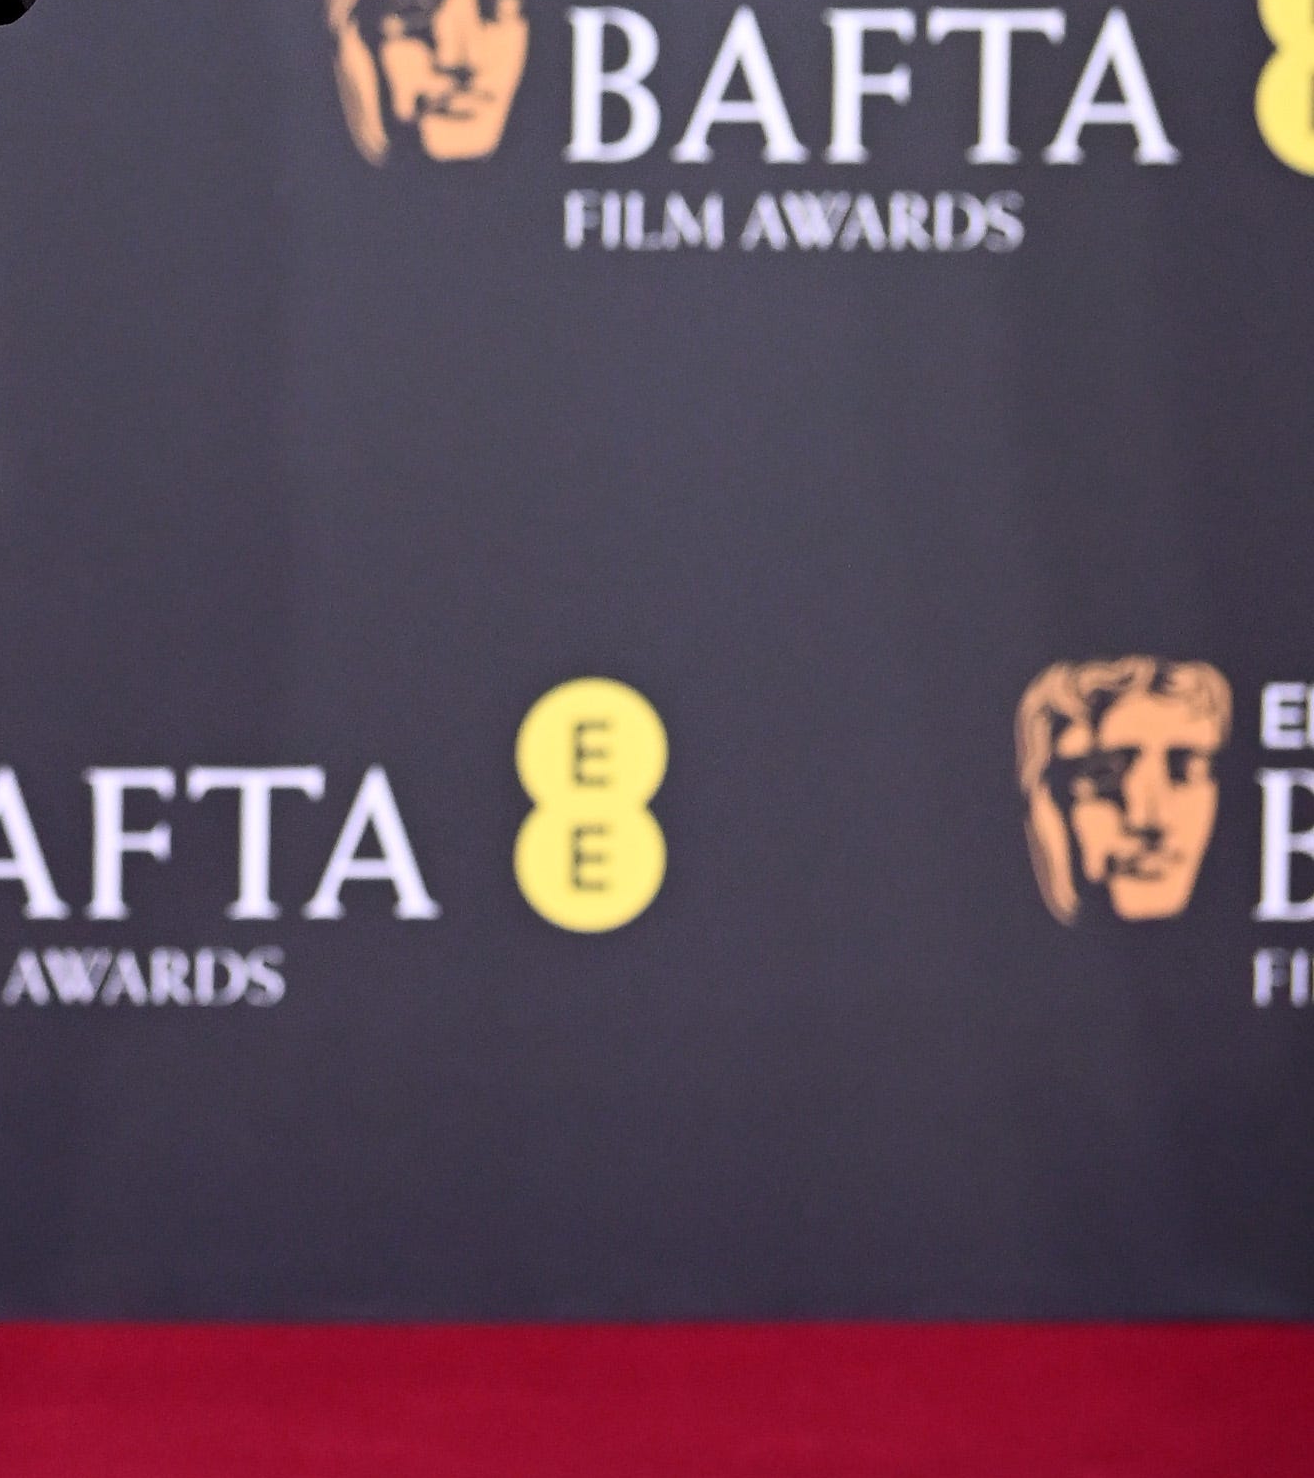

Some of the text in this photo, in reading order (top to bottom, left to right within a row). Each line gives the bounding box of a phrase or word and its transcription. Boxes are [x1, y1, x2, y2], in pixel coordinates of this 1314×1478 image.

[566, 7, 1176, 164] BAFTA
[564, 190, 1024, 250] FILM AWARDS
[1261, 682, 1314, 749] E
[4, 948, 285, 1006] AWARDS
